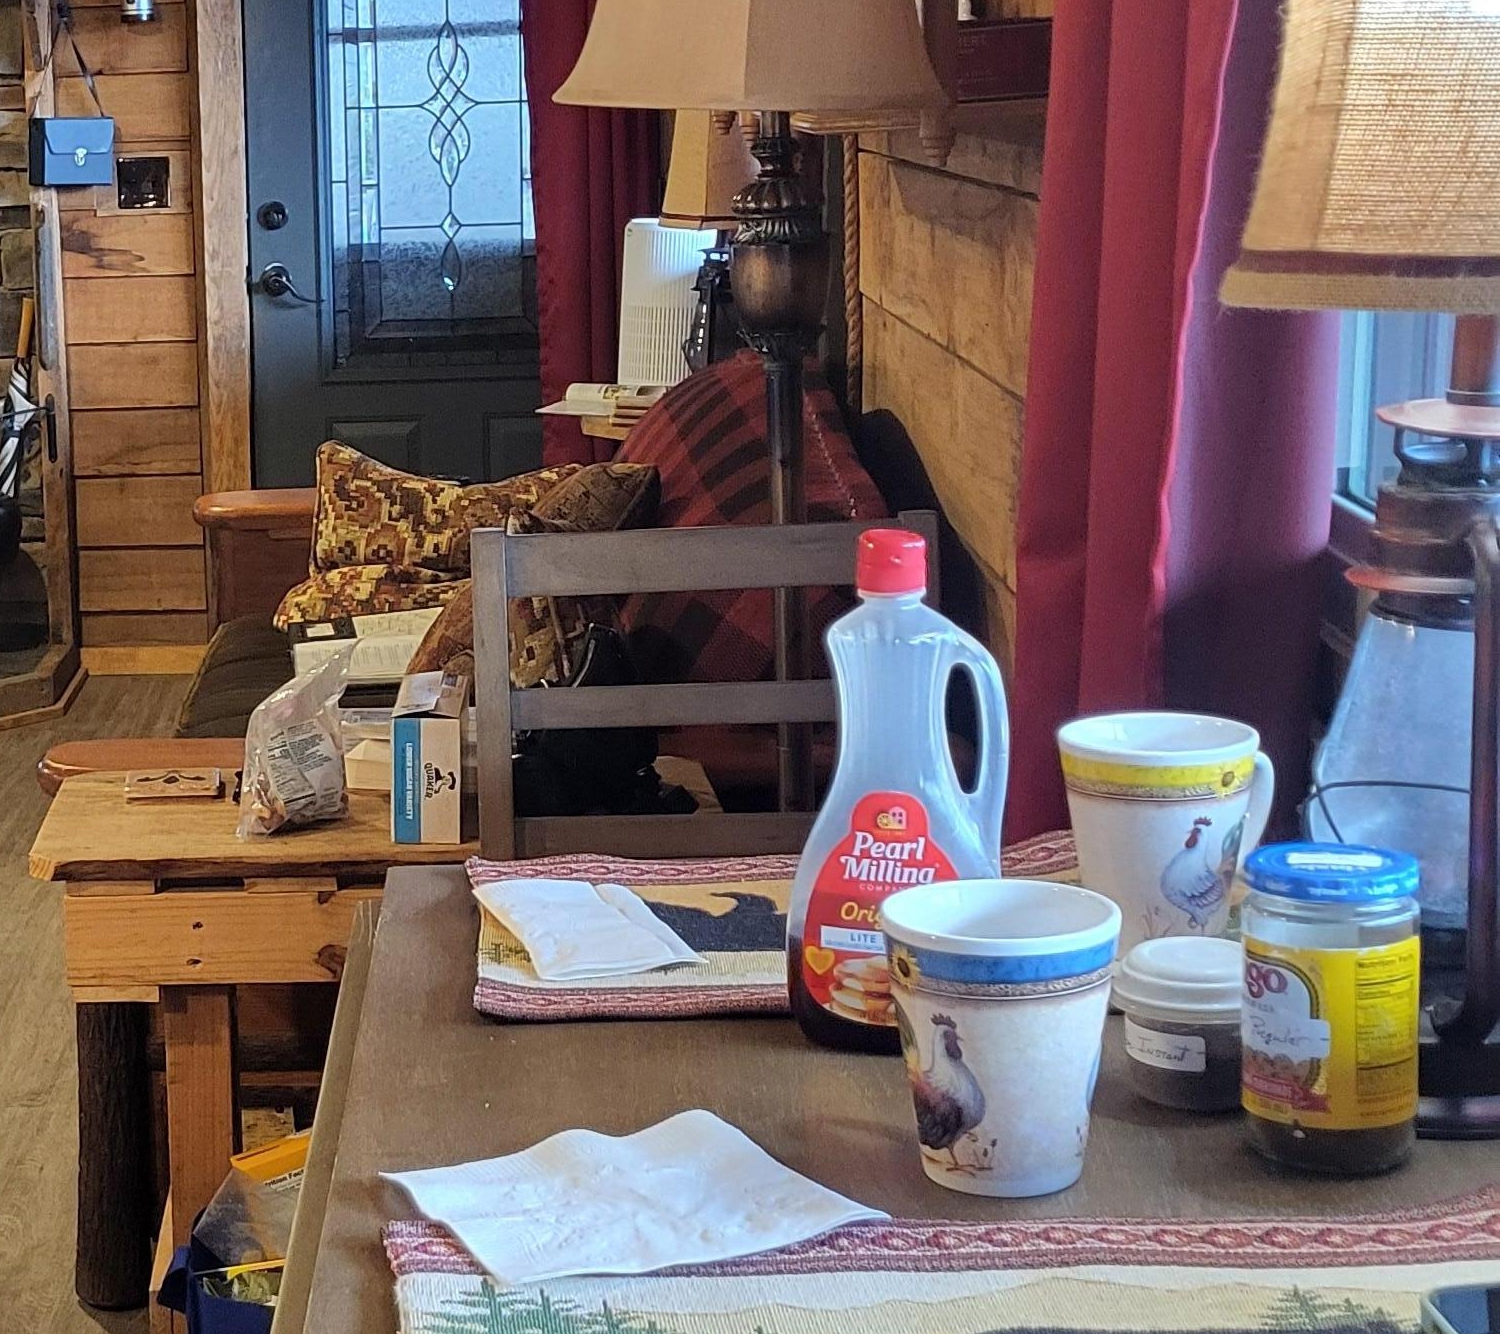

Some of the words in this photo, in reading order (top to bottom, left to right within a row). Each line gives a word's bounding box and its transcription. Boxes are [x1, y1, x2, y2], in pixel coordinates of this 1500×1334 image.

[424, 762, 435, 799] QUAKER
[851, 831, 926, 861] Pearl
[839, 855, 936, 884] Milling
[859, 882, 905, 892] COMPA
[841, 901, 882, 930] Orig
[850, 933, 877, 944] LITE
[288, 1168, 305, 1180] Fact
